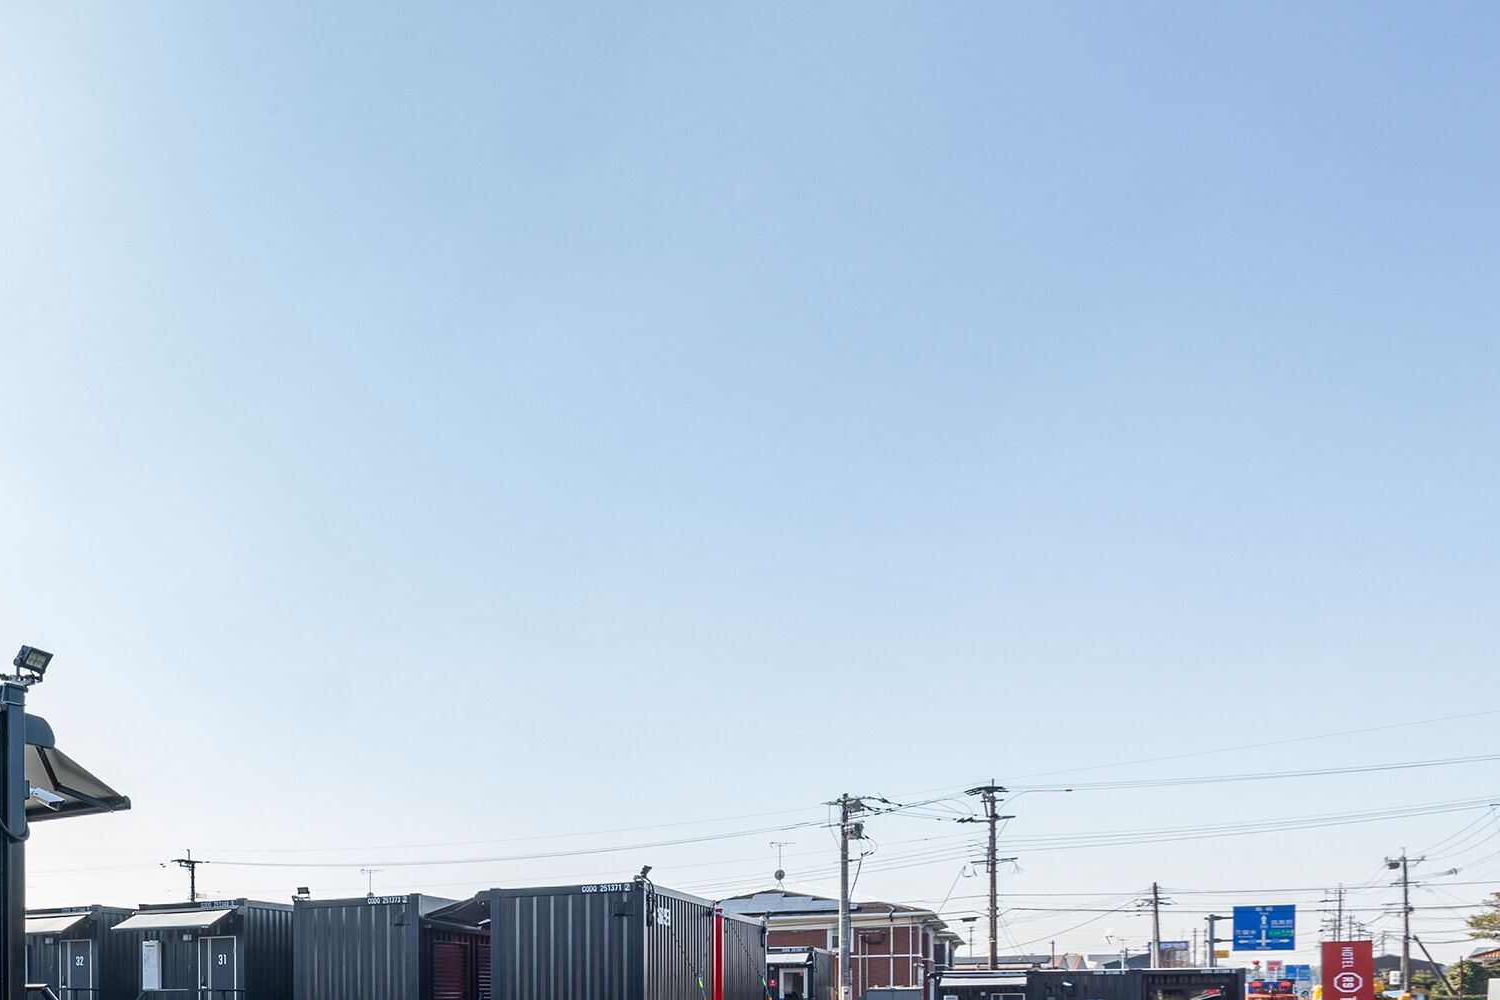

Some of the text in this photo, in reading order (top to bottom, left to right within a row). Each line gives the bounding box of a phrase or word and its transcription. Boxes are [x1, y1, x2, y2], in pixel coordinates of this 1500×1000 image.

[75, 955, 84, 966] 32
[218, 954, 227, 965] 31
[1341, 946, 1354, 968] HOTEL
[1342, 976, 1354, 988] R9
